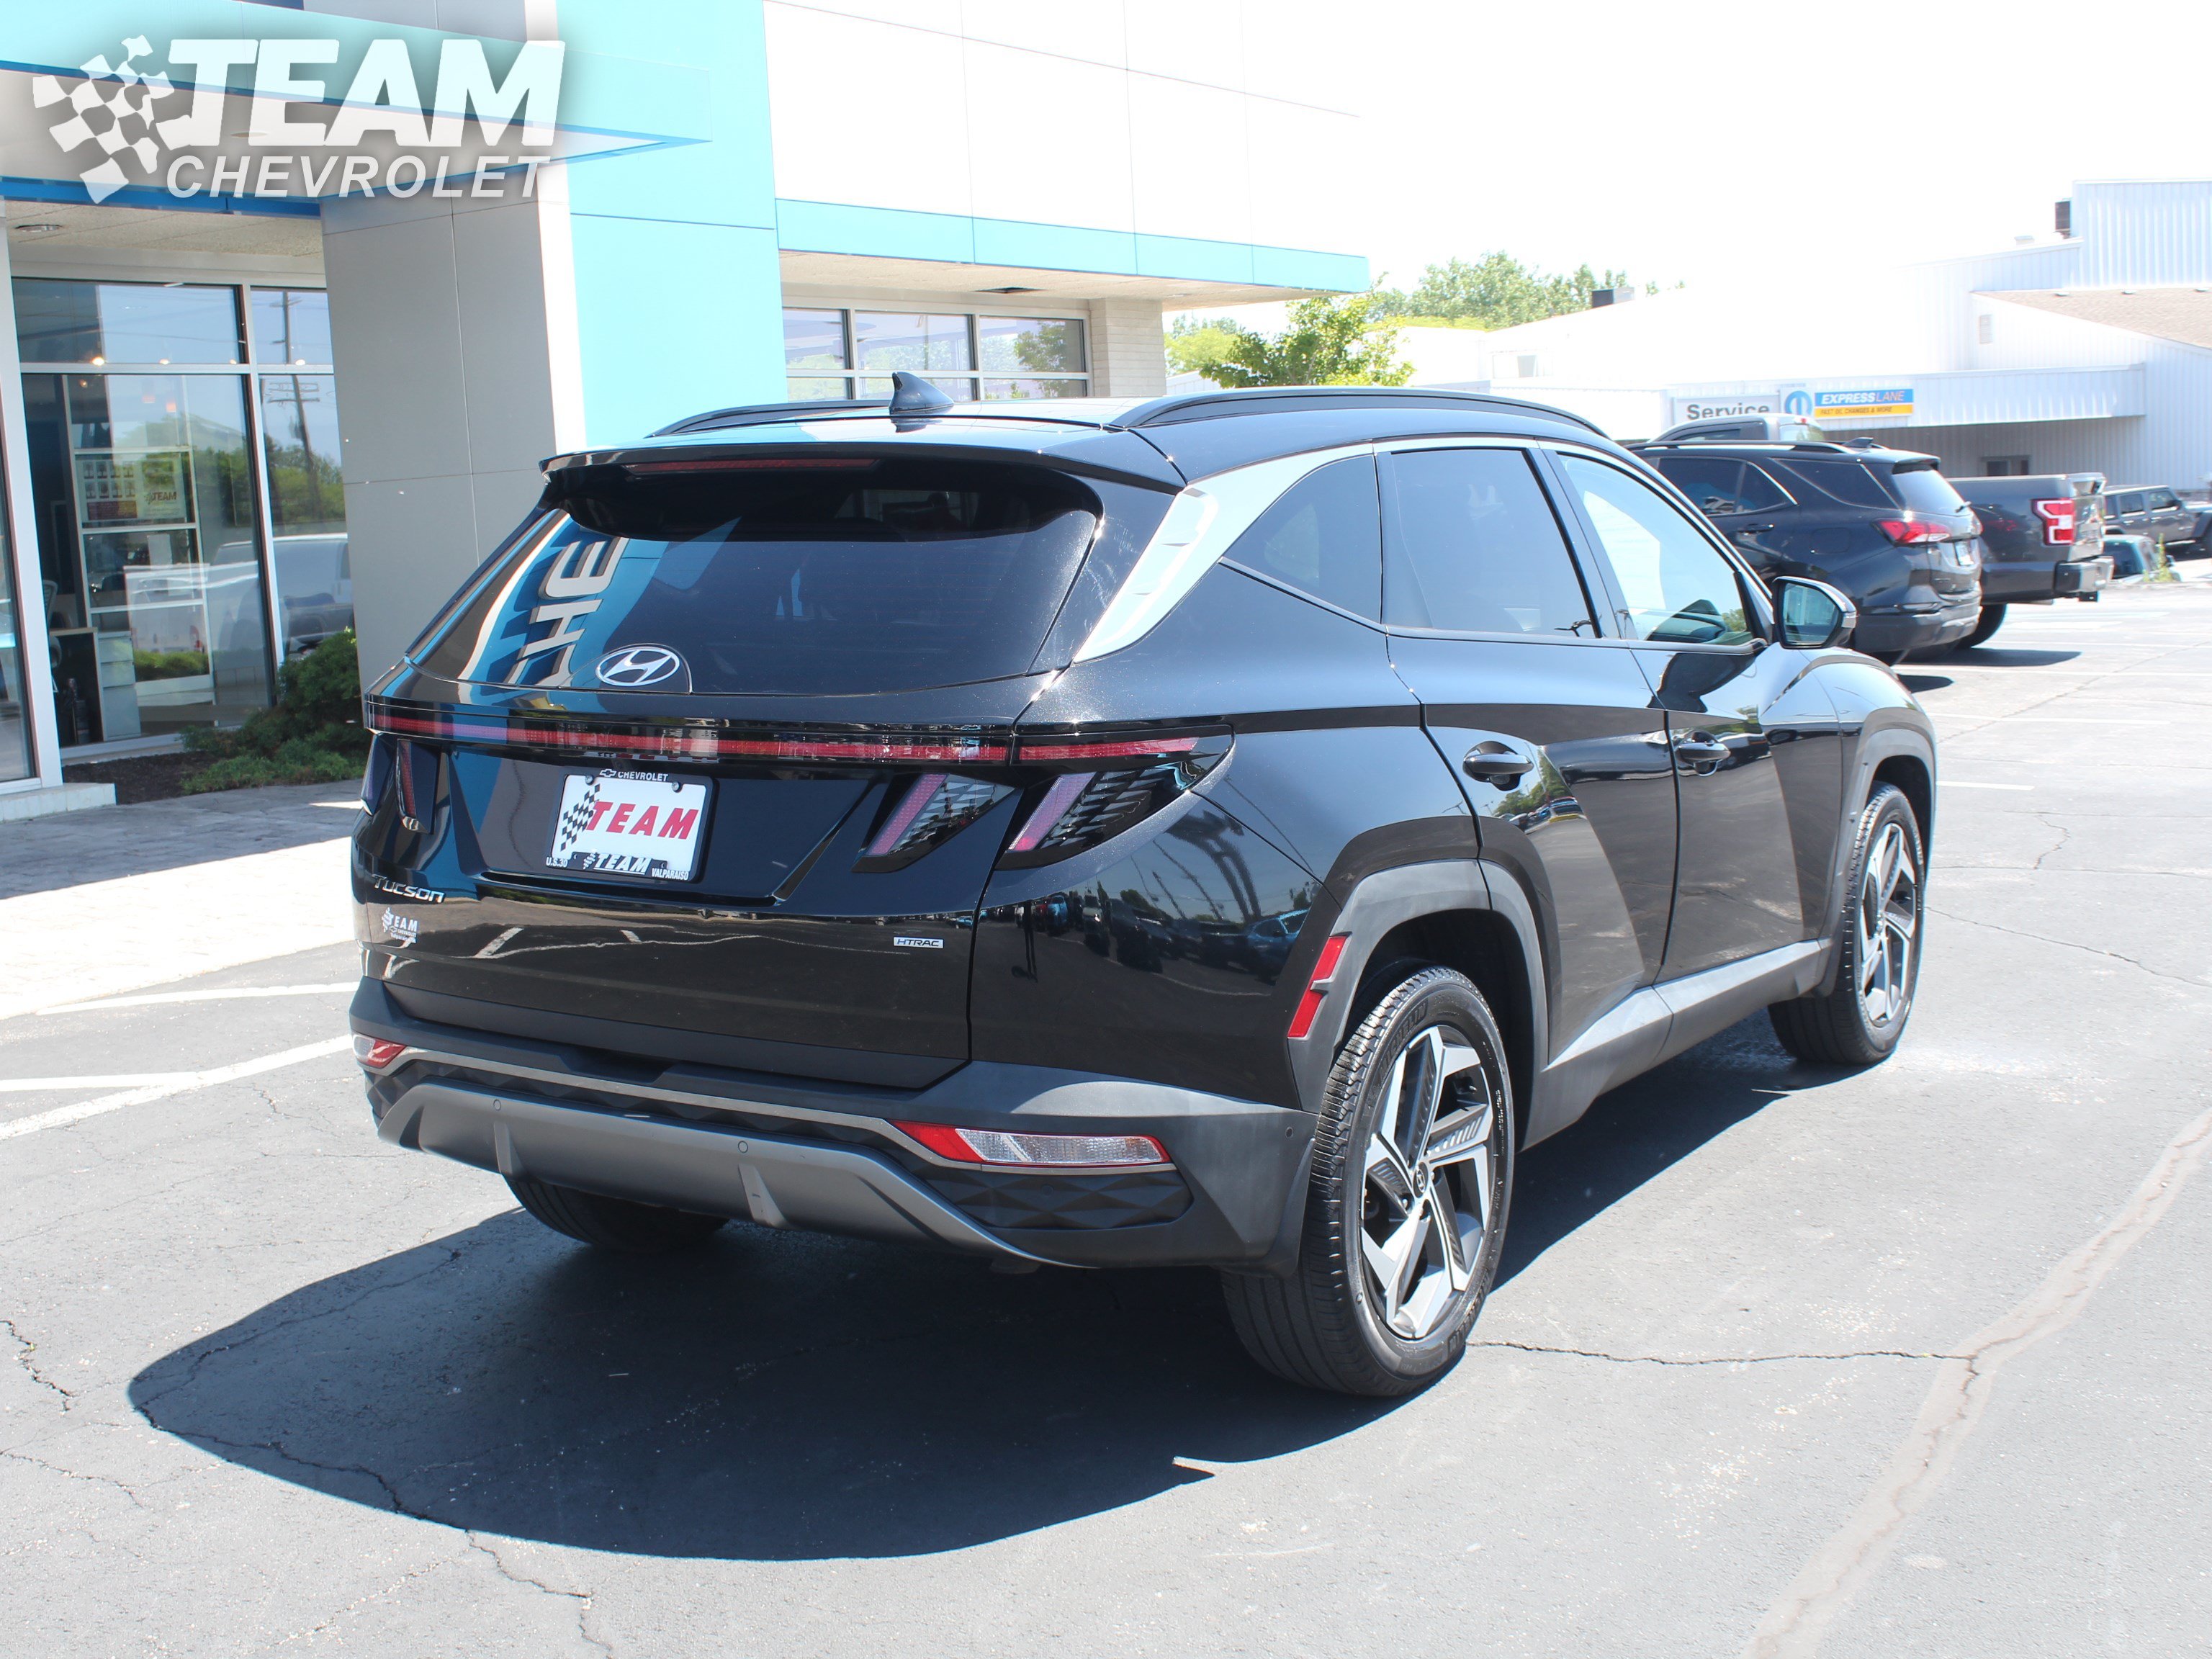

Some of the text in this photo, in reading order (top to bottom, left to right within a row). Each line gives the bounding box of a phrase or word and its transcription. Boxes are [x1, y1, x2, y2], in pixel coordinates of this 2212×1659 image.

[1687, 402, 1770, 421] Service
[1845, 406, 1870, 415] CHANGES
[151, 491, 177, 502] TEAM
[617, 770, 668, 782] CHEVROLET
[586, 801, 698, 840] TEAM
[594, 853, 652, 873] TEAM
[651, 867, 689, 881] VALPARAISO
[896, 938, 940, 947] HTRAC
